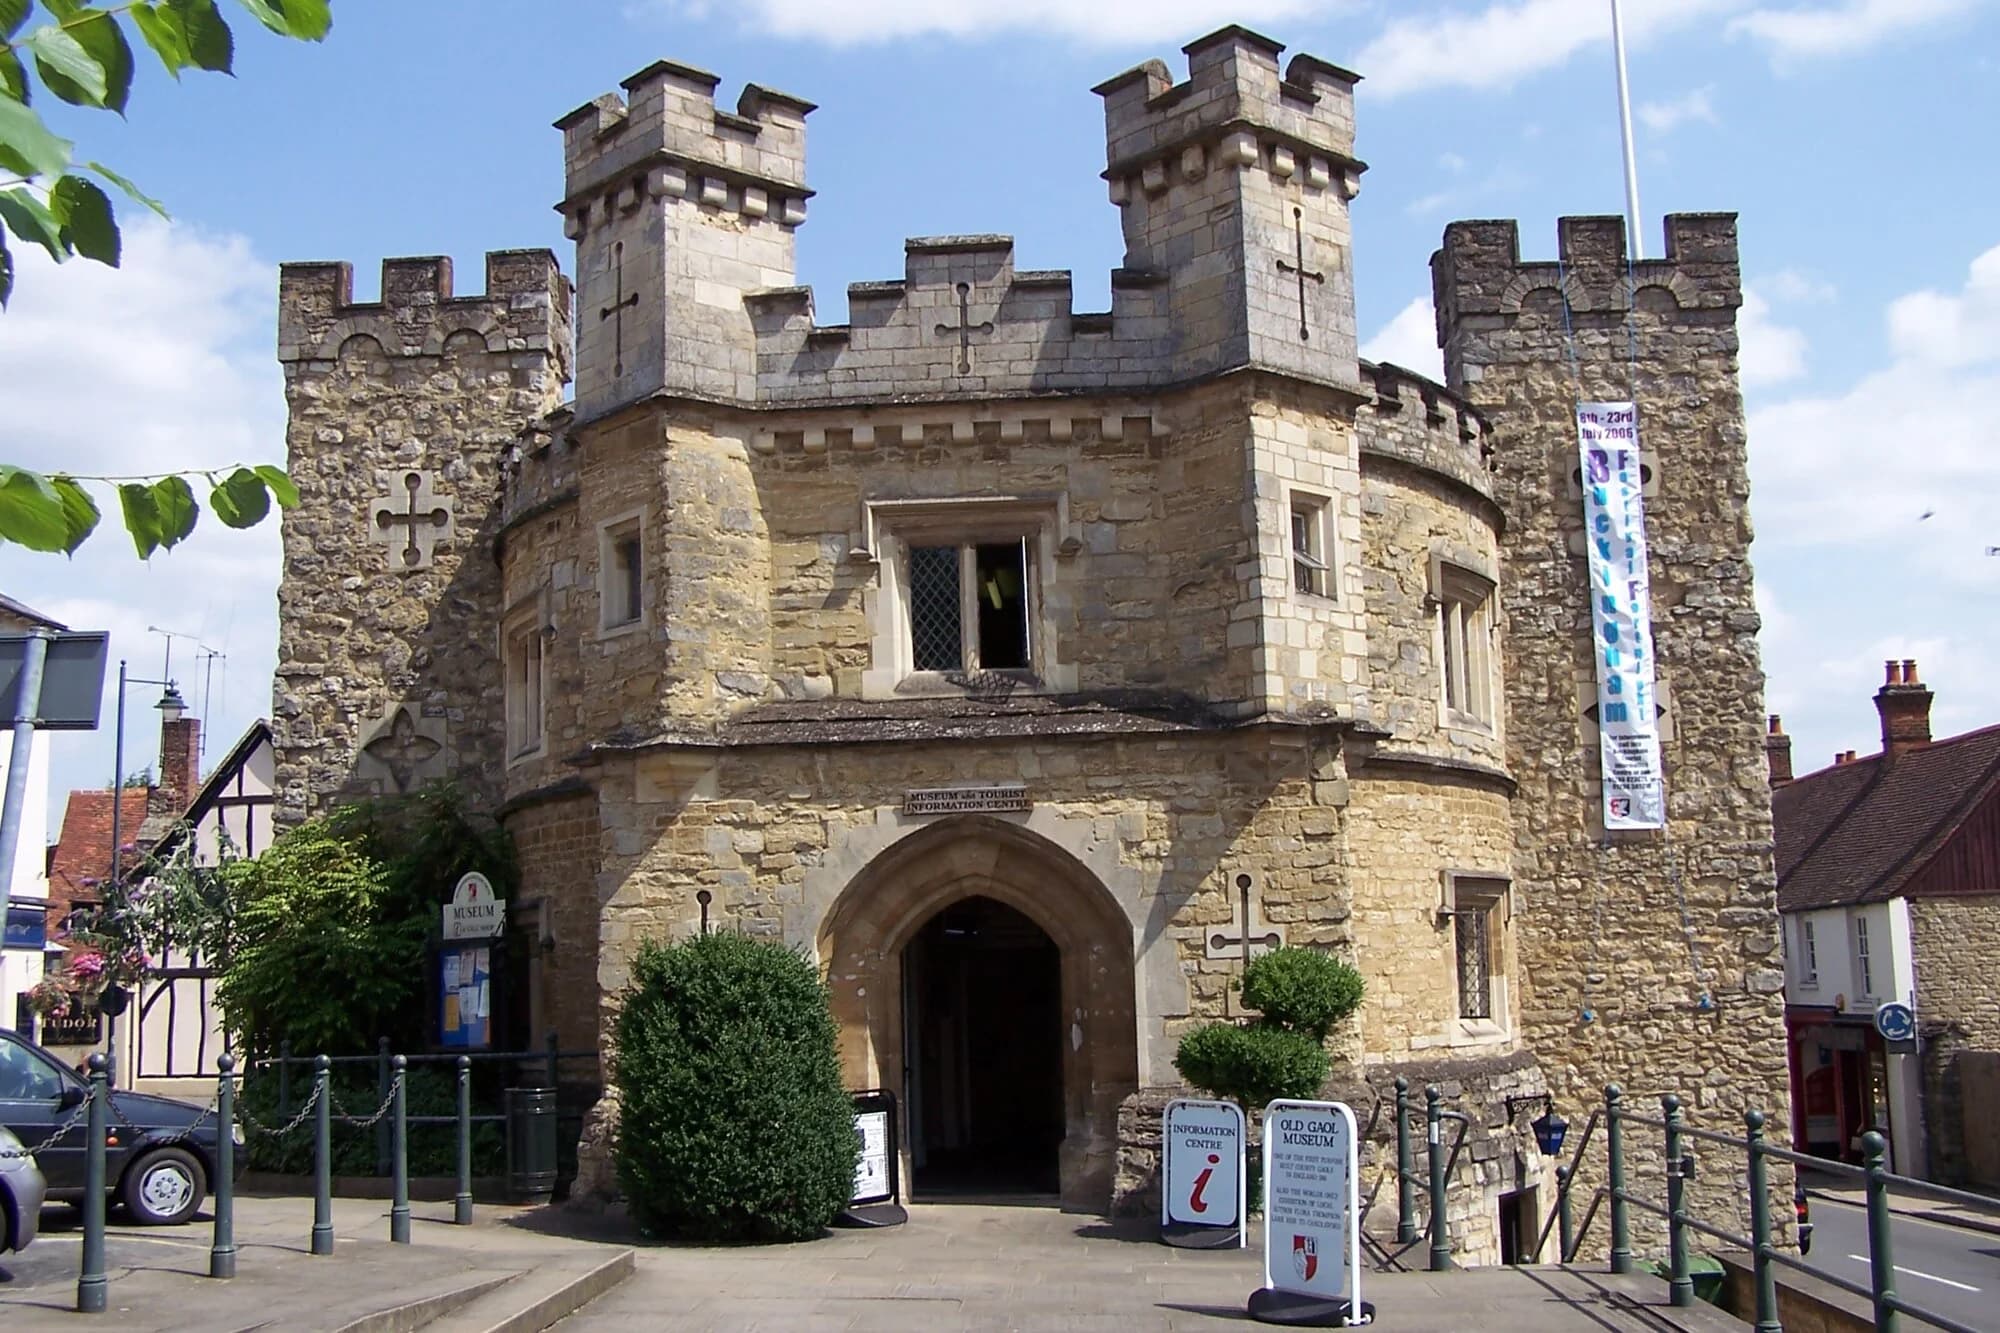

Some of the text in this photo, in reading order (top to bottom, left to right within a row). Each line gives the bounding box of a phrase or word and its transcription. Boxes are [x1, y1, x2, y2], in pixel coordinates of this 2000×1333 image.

[1579, 412, 1598, 424] 8th
[1606, 411, 1633, 424] 23rd
[1582, 427, 1634, 440] July 2006
[911, 791, 958, 801] MUSEUM
[979, 789, 1026, 799] TOURIST
[906, 799, 1031, 812] INFORMATION CENTRE
[454, 905, 494, 920] MUSEUM
[1173, 1124, 1236, 1137] INFORMATION
[1280, 1119, 1339, 1134] OLD GAOL
[1185, 1139, 1223, 1150] CENTRE
[1283, 1132, 1335, 1148] MUSEUM
